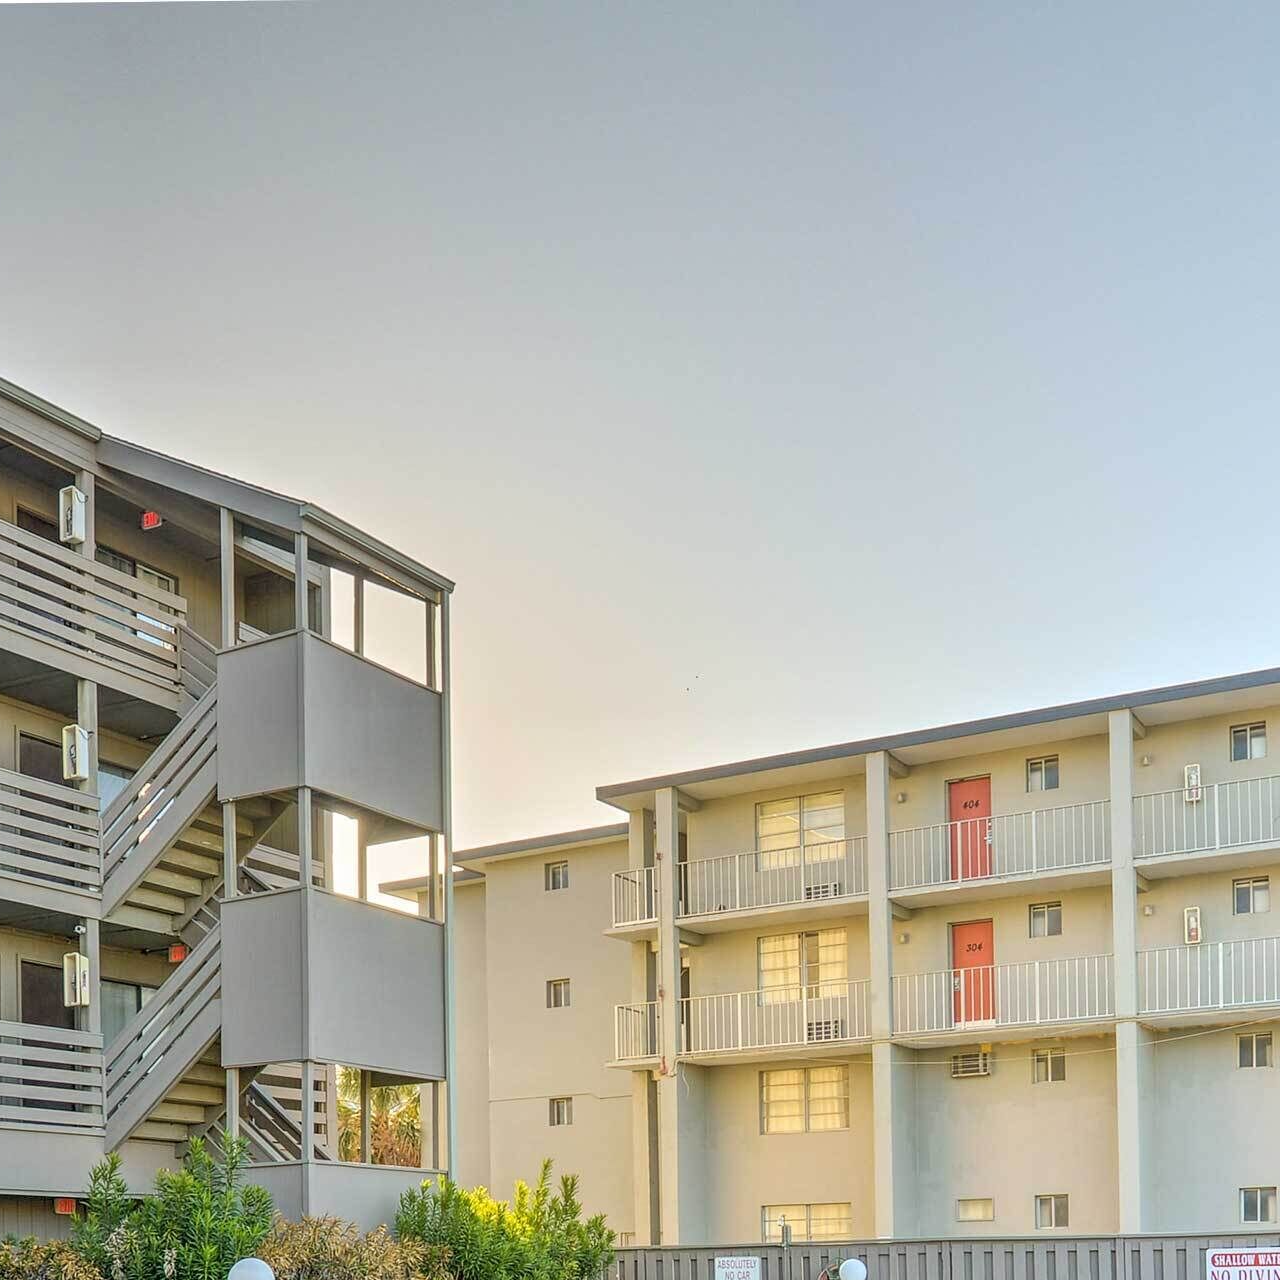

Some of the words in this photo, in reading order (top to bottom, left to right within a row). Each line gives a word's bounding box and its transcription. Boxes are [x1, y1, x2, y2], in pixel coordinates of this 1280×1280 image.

[962, 800, 980, 809] 404
[966, 942, 984, 952] 304
[717, 1258, 758, 1269] ABSOLUTELY
[1214, 1254, 1255, 1266] SHALLOW
[725, 1271, 735, 1280] NO
[737, 1270, 751, 1280] CAR
